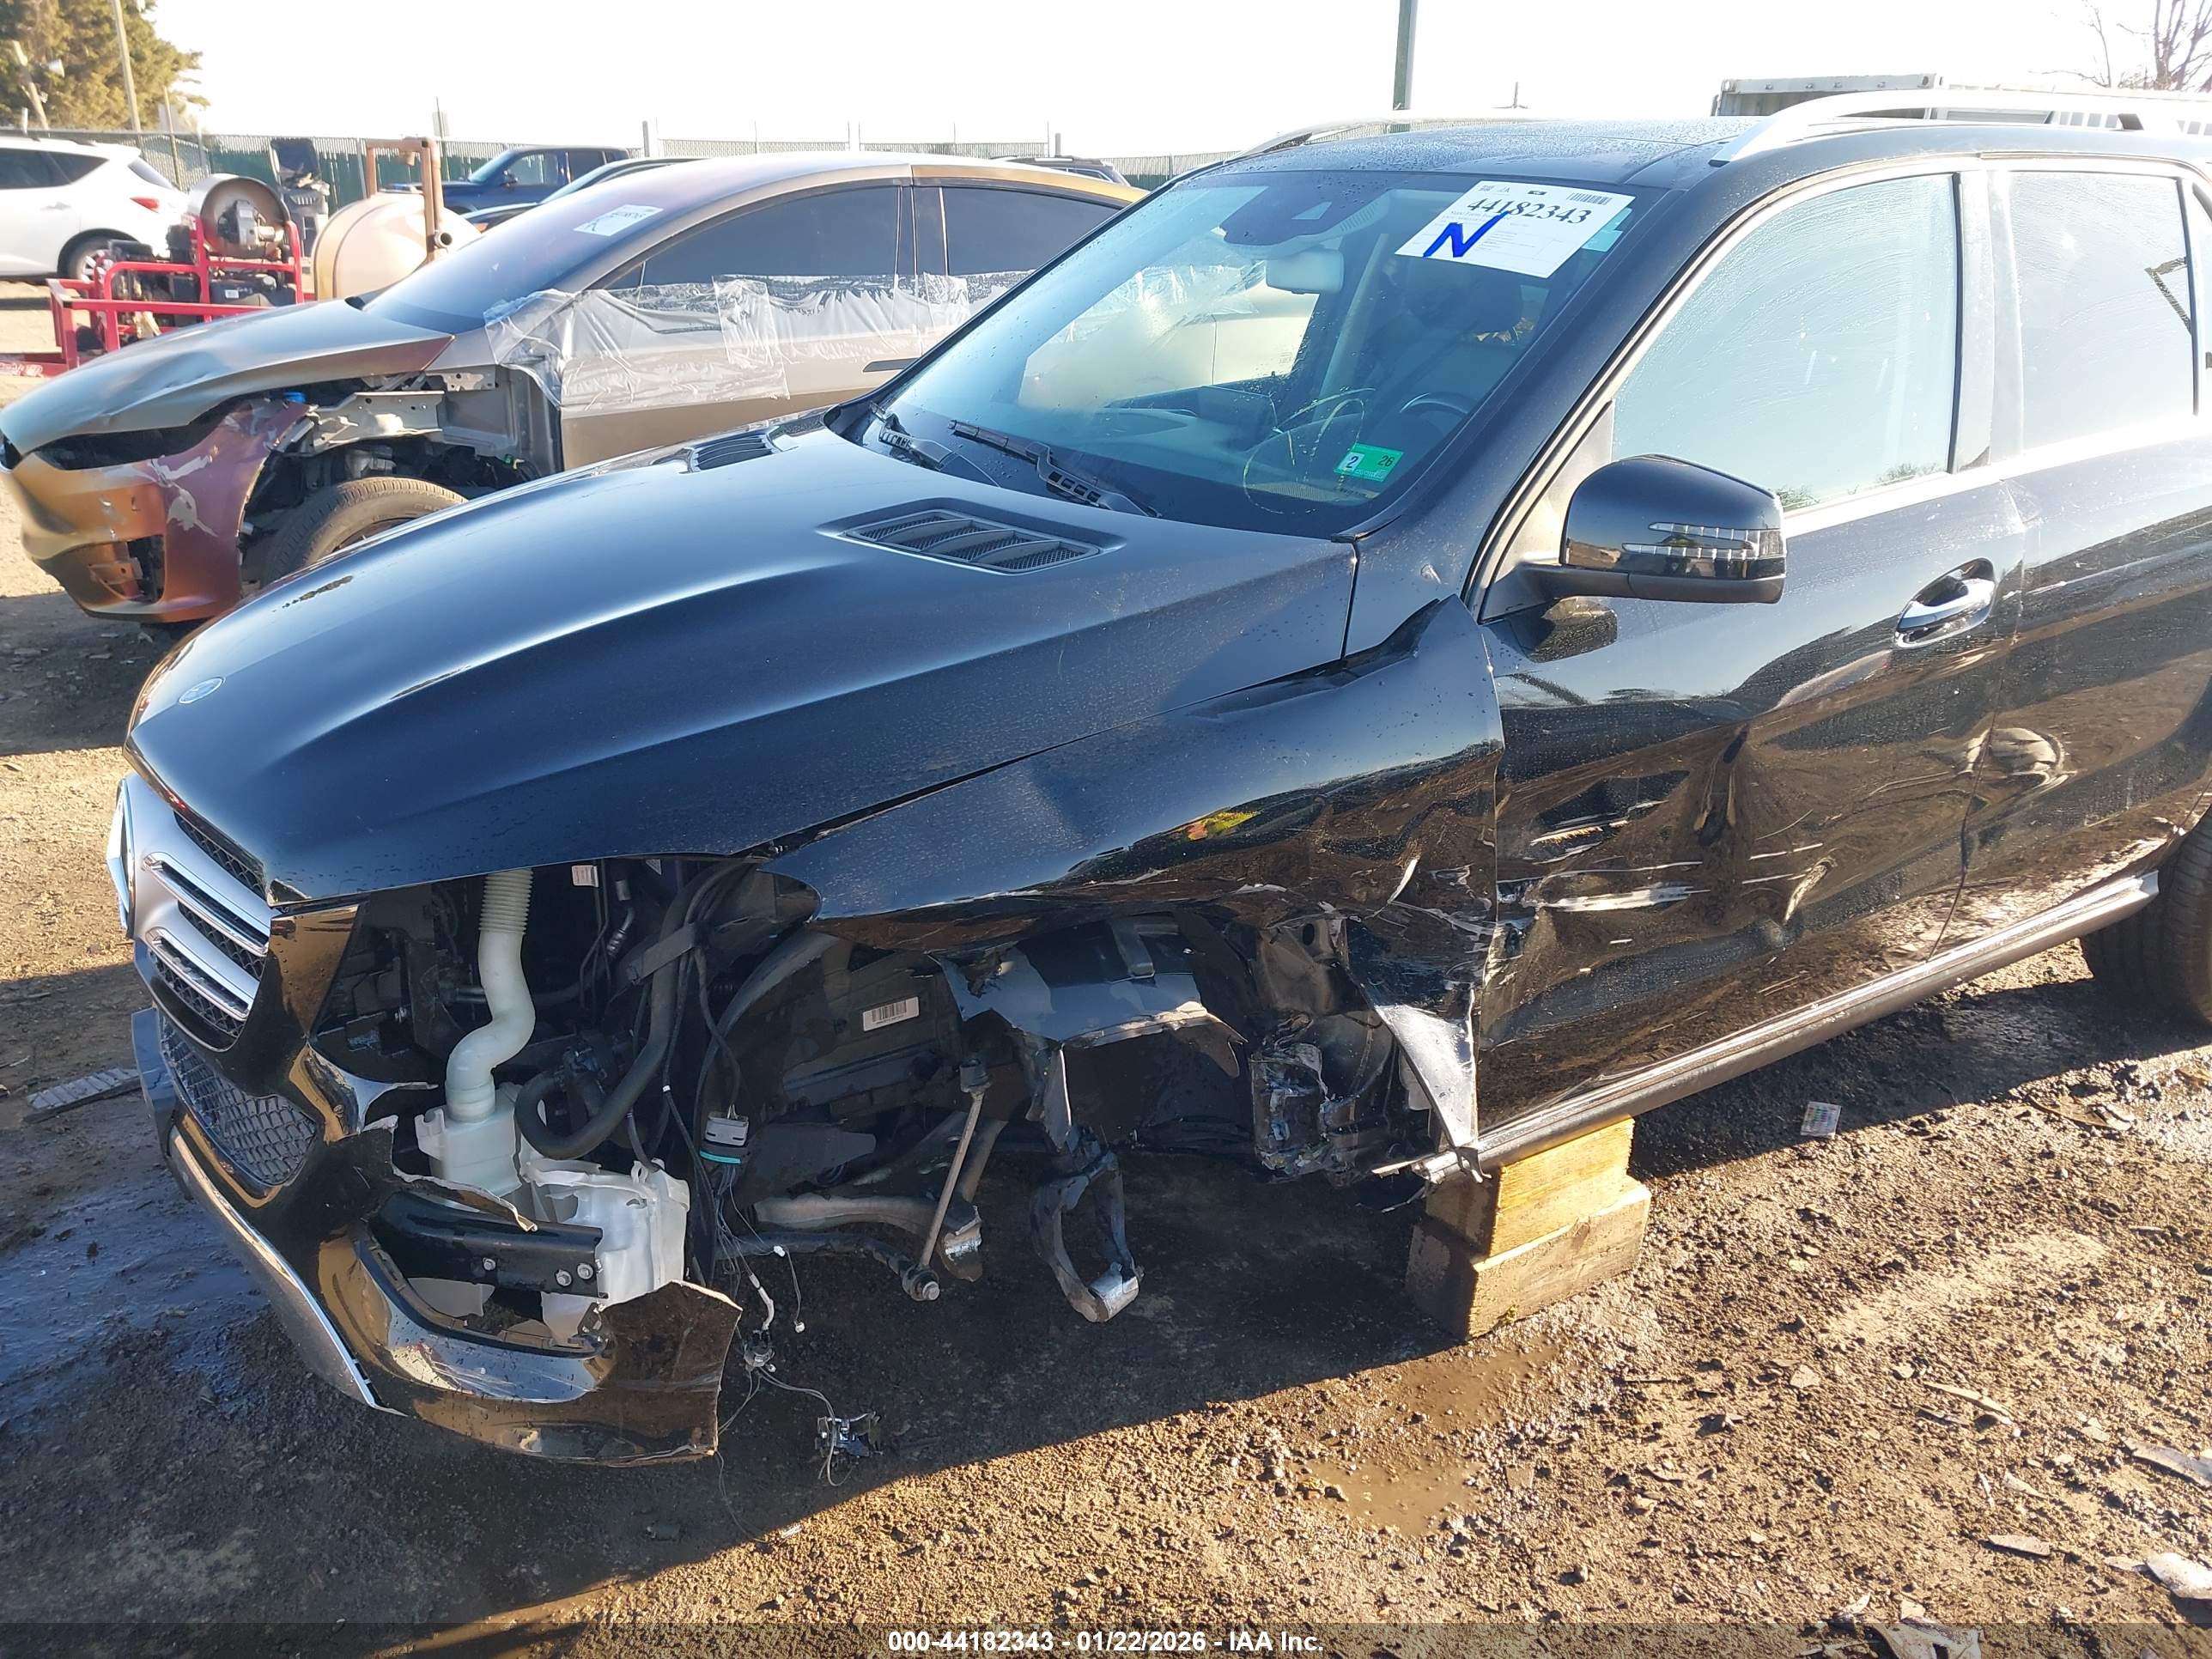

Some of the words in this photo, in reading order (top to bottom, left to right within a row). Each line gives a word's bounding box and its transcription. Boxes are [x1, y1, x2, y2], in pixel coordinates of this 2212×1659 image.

[1467, 198, 1593, 225] 44182343
[1423, 211, 1510, 258] N
[1346, 455, 1359, 468] 2
[1377, 455, 1395, 467] 26
